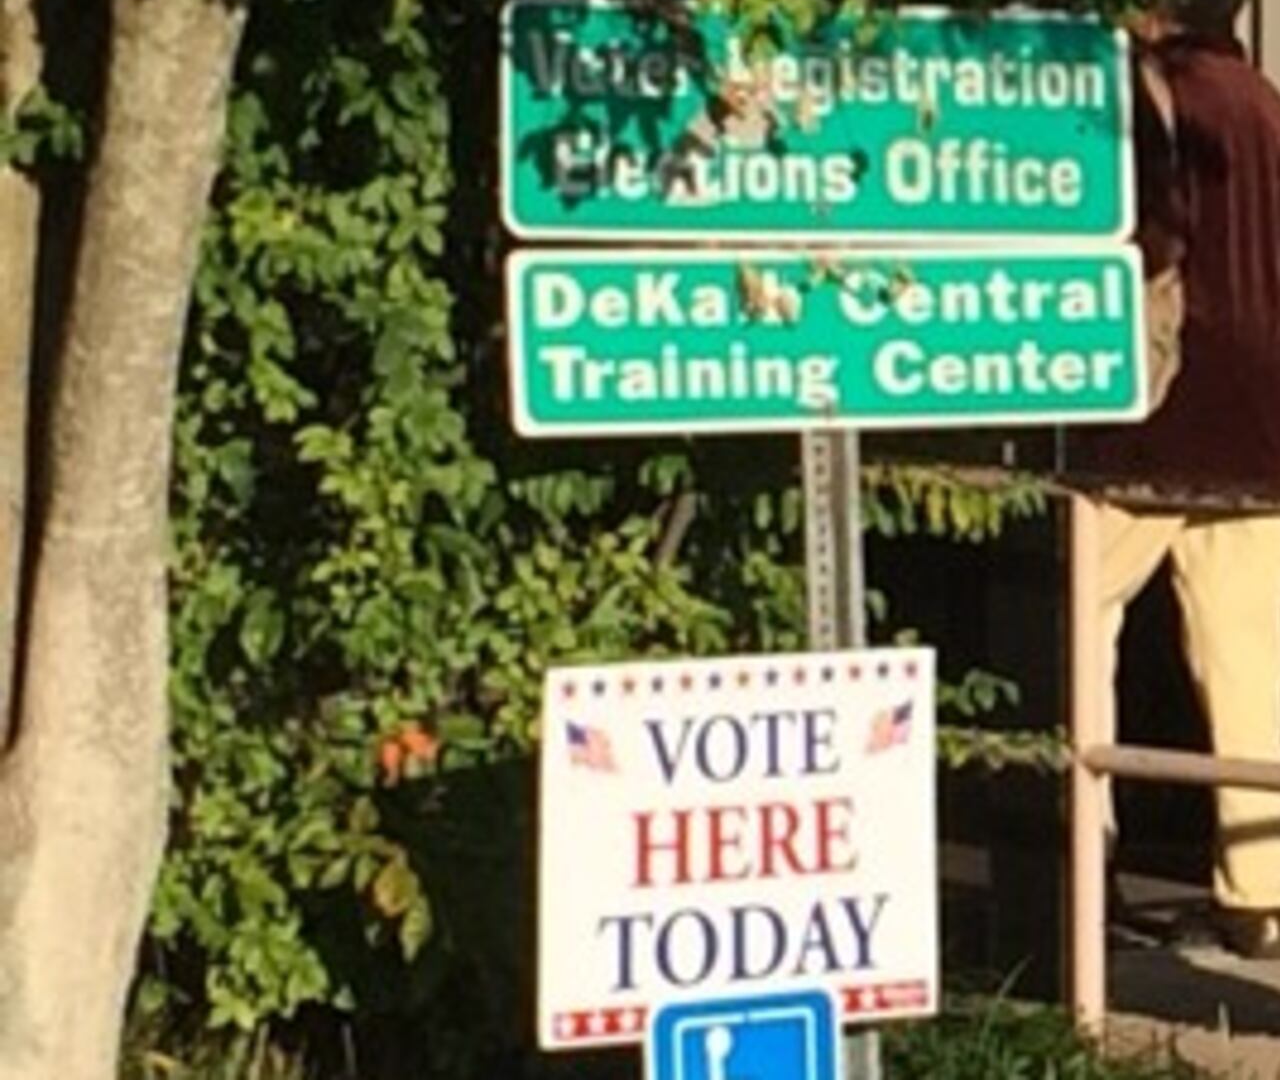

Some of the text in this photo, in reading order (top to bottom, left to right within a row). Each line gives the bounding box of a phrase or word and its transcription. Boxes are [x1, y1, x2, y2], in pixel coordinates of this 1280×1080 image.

[884, 138, 1083, 204] Office
[839, 265, 1122, 324] Central
[538, 340, 1121, 408] Training Center
[645, 709, 841, 784] VOTE
[630, 797, 856, 887] HERE
[597, 893, 888, 992] TODAY
